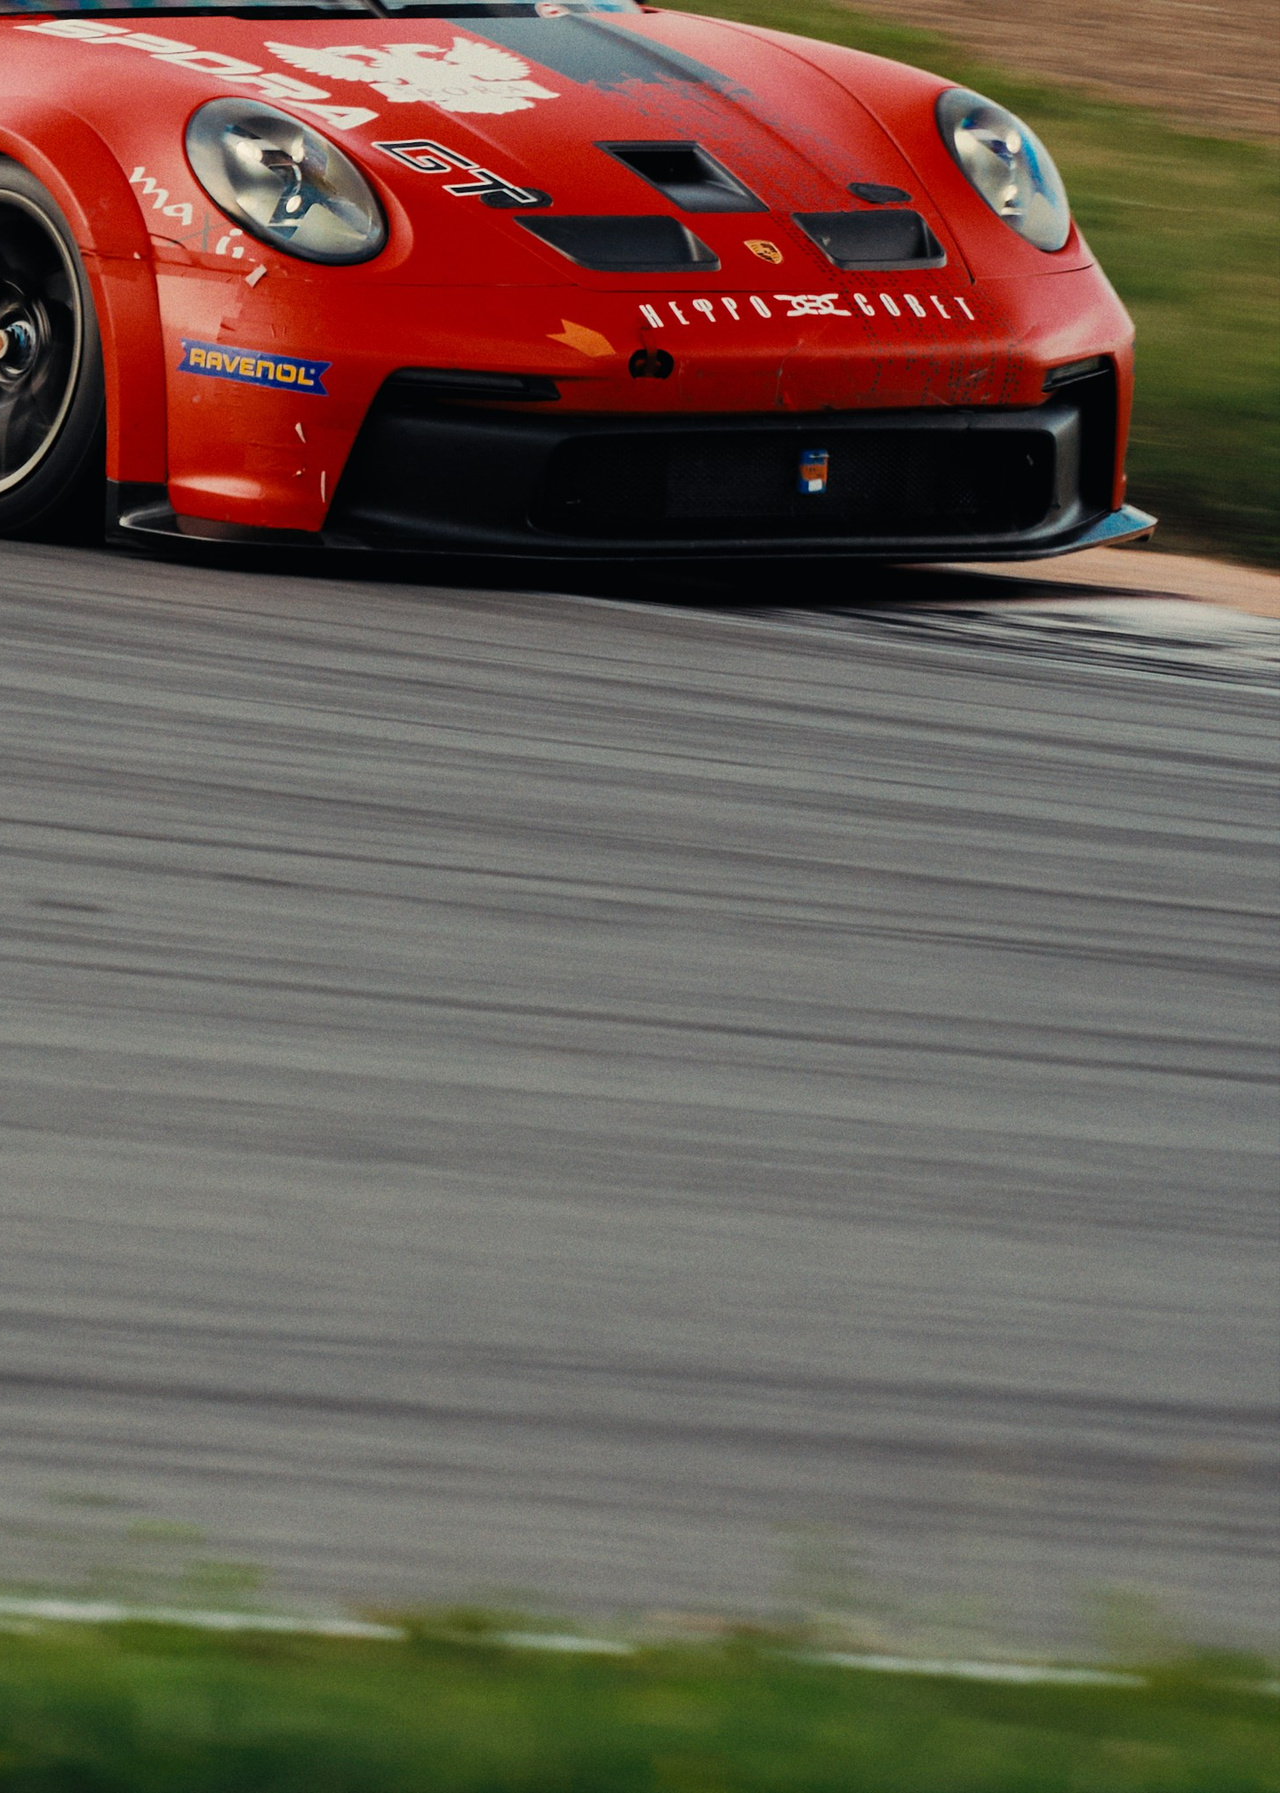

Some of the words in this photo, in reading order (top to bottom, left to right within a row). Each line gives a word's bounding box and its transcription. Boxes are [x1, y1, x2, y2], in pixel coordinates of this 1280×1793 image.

[13, 19, 381, 131] SPORA
[371, 139, 538, 204] GT
[189, 347, 315, 386] RAVENOL
